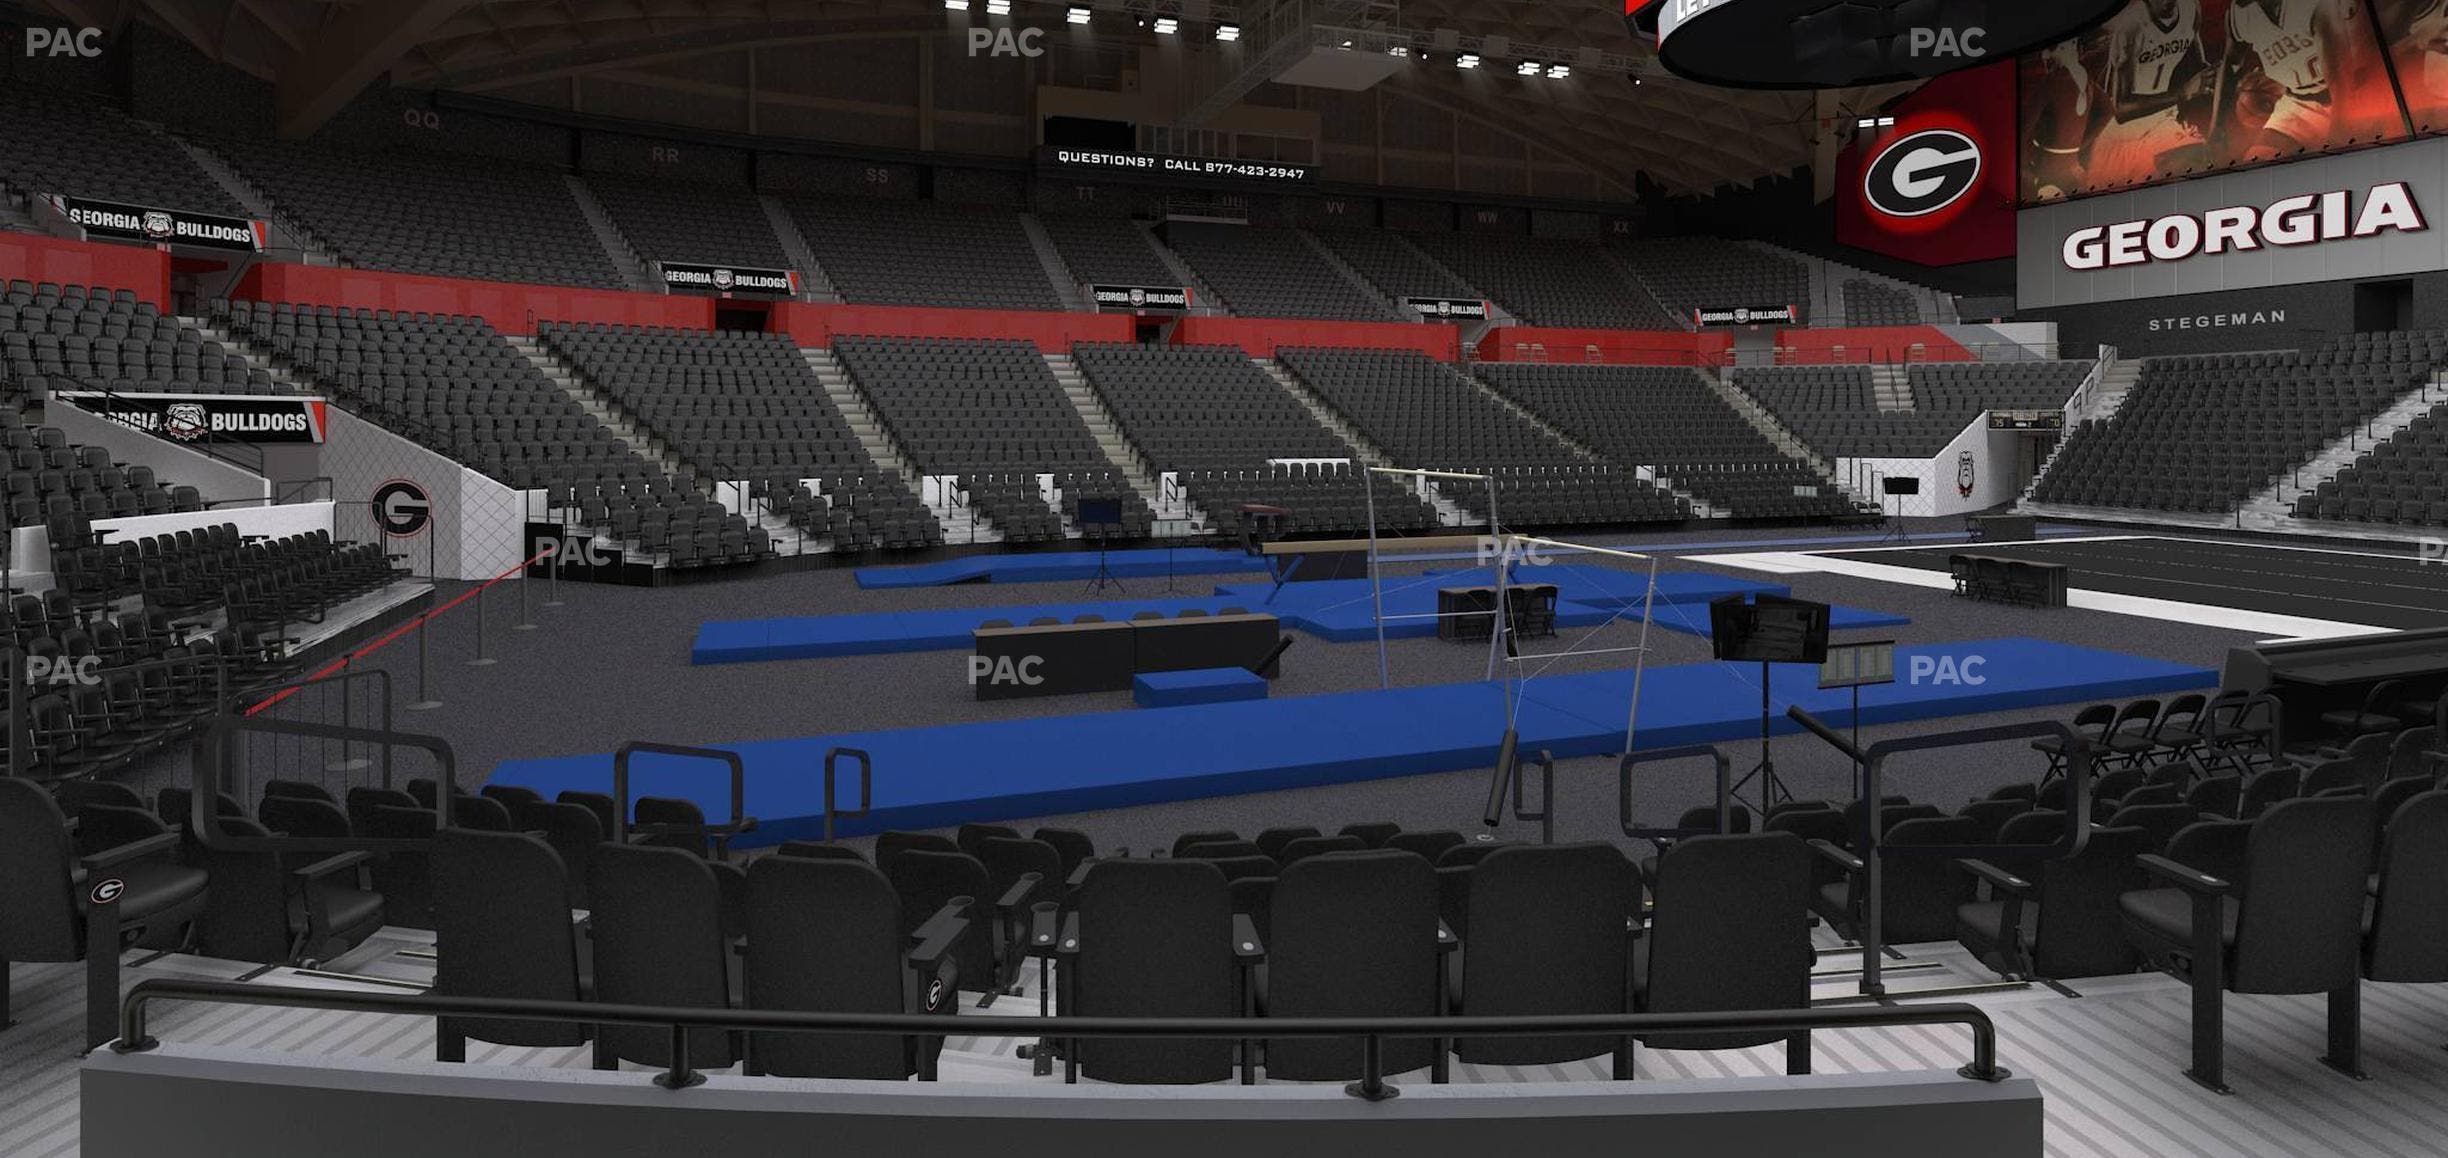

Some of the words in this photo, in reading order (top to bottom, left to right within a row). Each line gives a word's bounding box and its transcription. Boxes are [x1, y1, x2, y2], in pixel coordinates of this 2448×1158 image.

[403, 109, 440, 130] QQ
[652, 147, 680, 163] RR
[1058, 151, 1155, 168] QUESTIONS?
[1165, 159, 1201, 172] CALL
[1206, 163, 1304, 180] 877-423-2947
[866, 168, 889, 183] SS
[1866, 130, 1981, 216] G
[69, 208, 141, 231] GEORGIA
[177, 221, 250, 243] BULLDOGS
[2062, 181, 2428, 271] GEORGIA
[664, 270, 712, 285] GEORGIA
[735, 275, 787, 289] BULLDOGS
[1096, 291, 1129, 302] GEORGIA
[1145, 293, 1184, 305] BULLDOGS
[1451, 305, 1483, 314] BULLDOGS
[1702, 312, 1734, 321] GEORGIA
[1749, 310, 1788, 320] BULLDOGS
[2149, 310, 2286, 331] STEGEMAN
[211, 412, 307, 432] BULLDOGS
[370, 481, 430, 535] G
[91, 879, 124, 903] G
